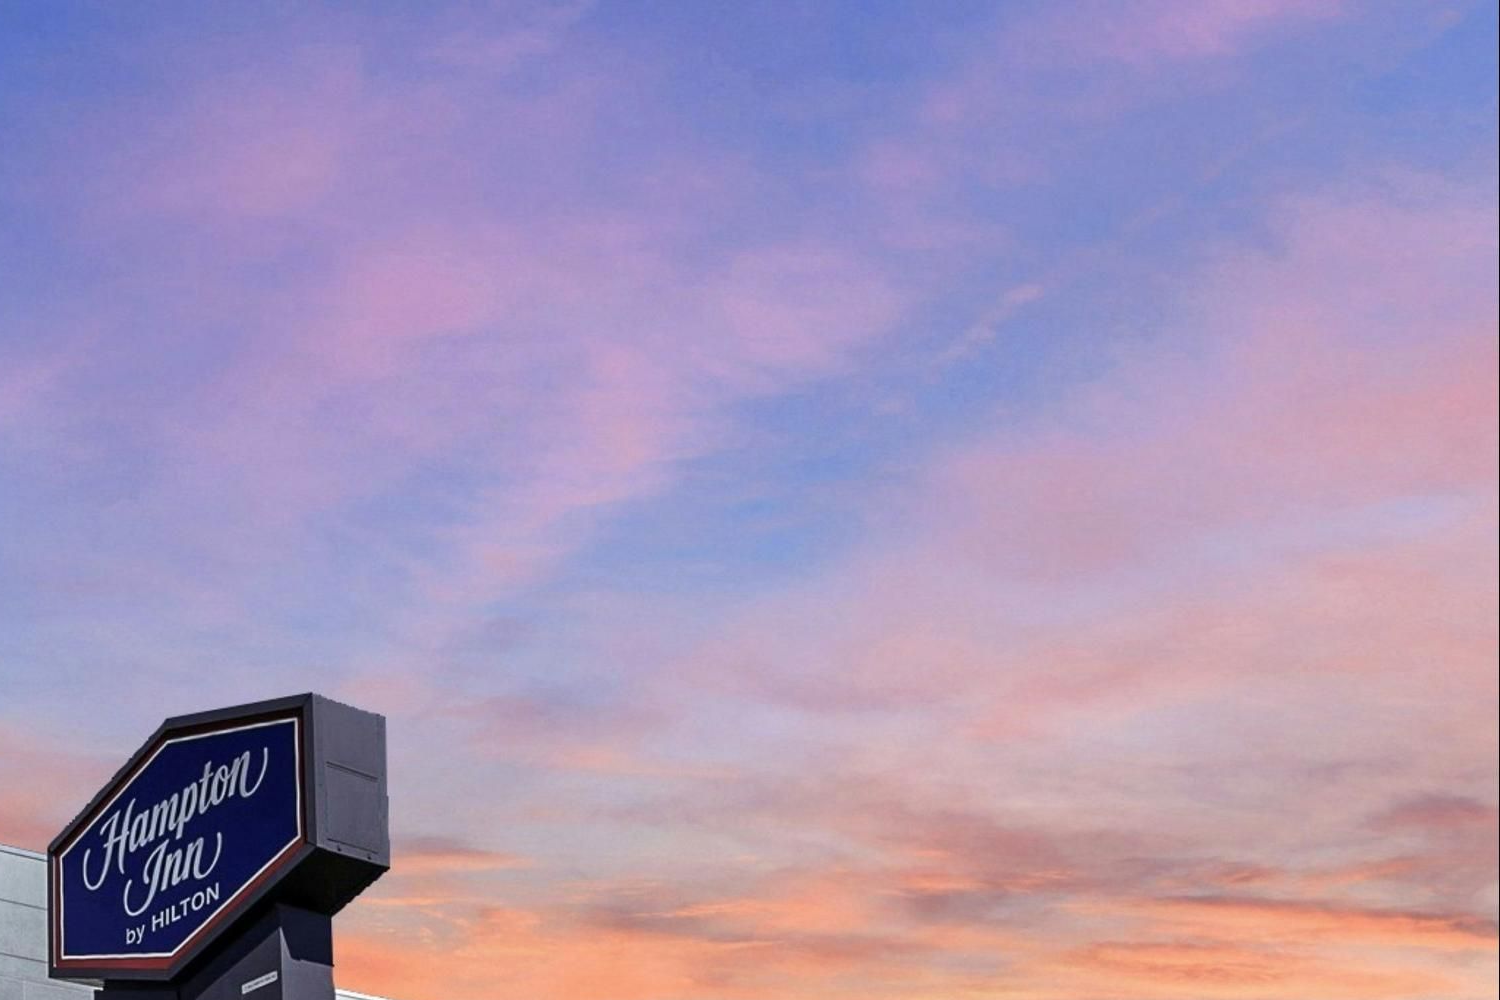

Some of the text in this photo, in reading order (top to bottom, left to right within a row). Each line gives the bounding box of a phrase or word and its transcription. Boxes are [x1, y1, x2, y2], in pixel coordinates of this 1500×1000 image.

[83, 747, 268, 890] Hampton
[123, 831, 222, 916] Inn
[126, 882, 220, 945] by HILTON
